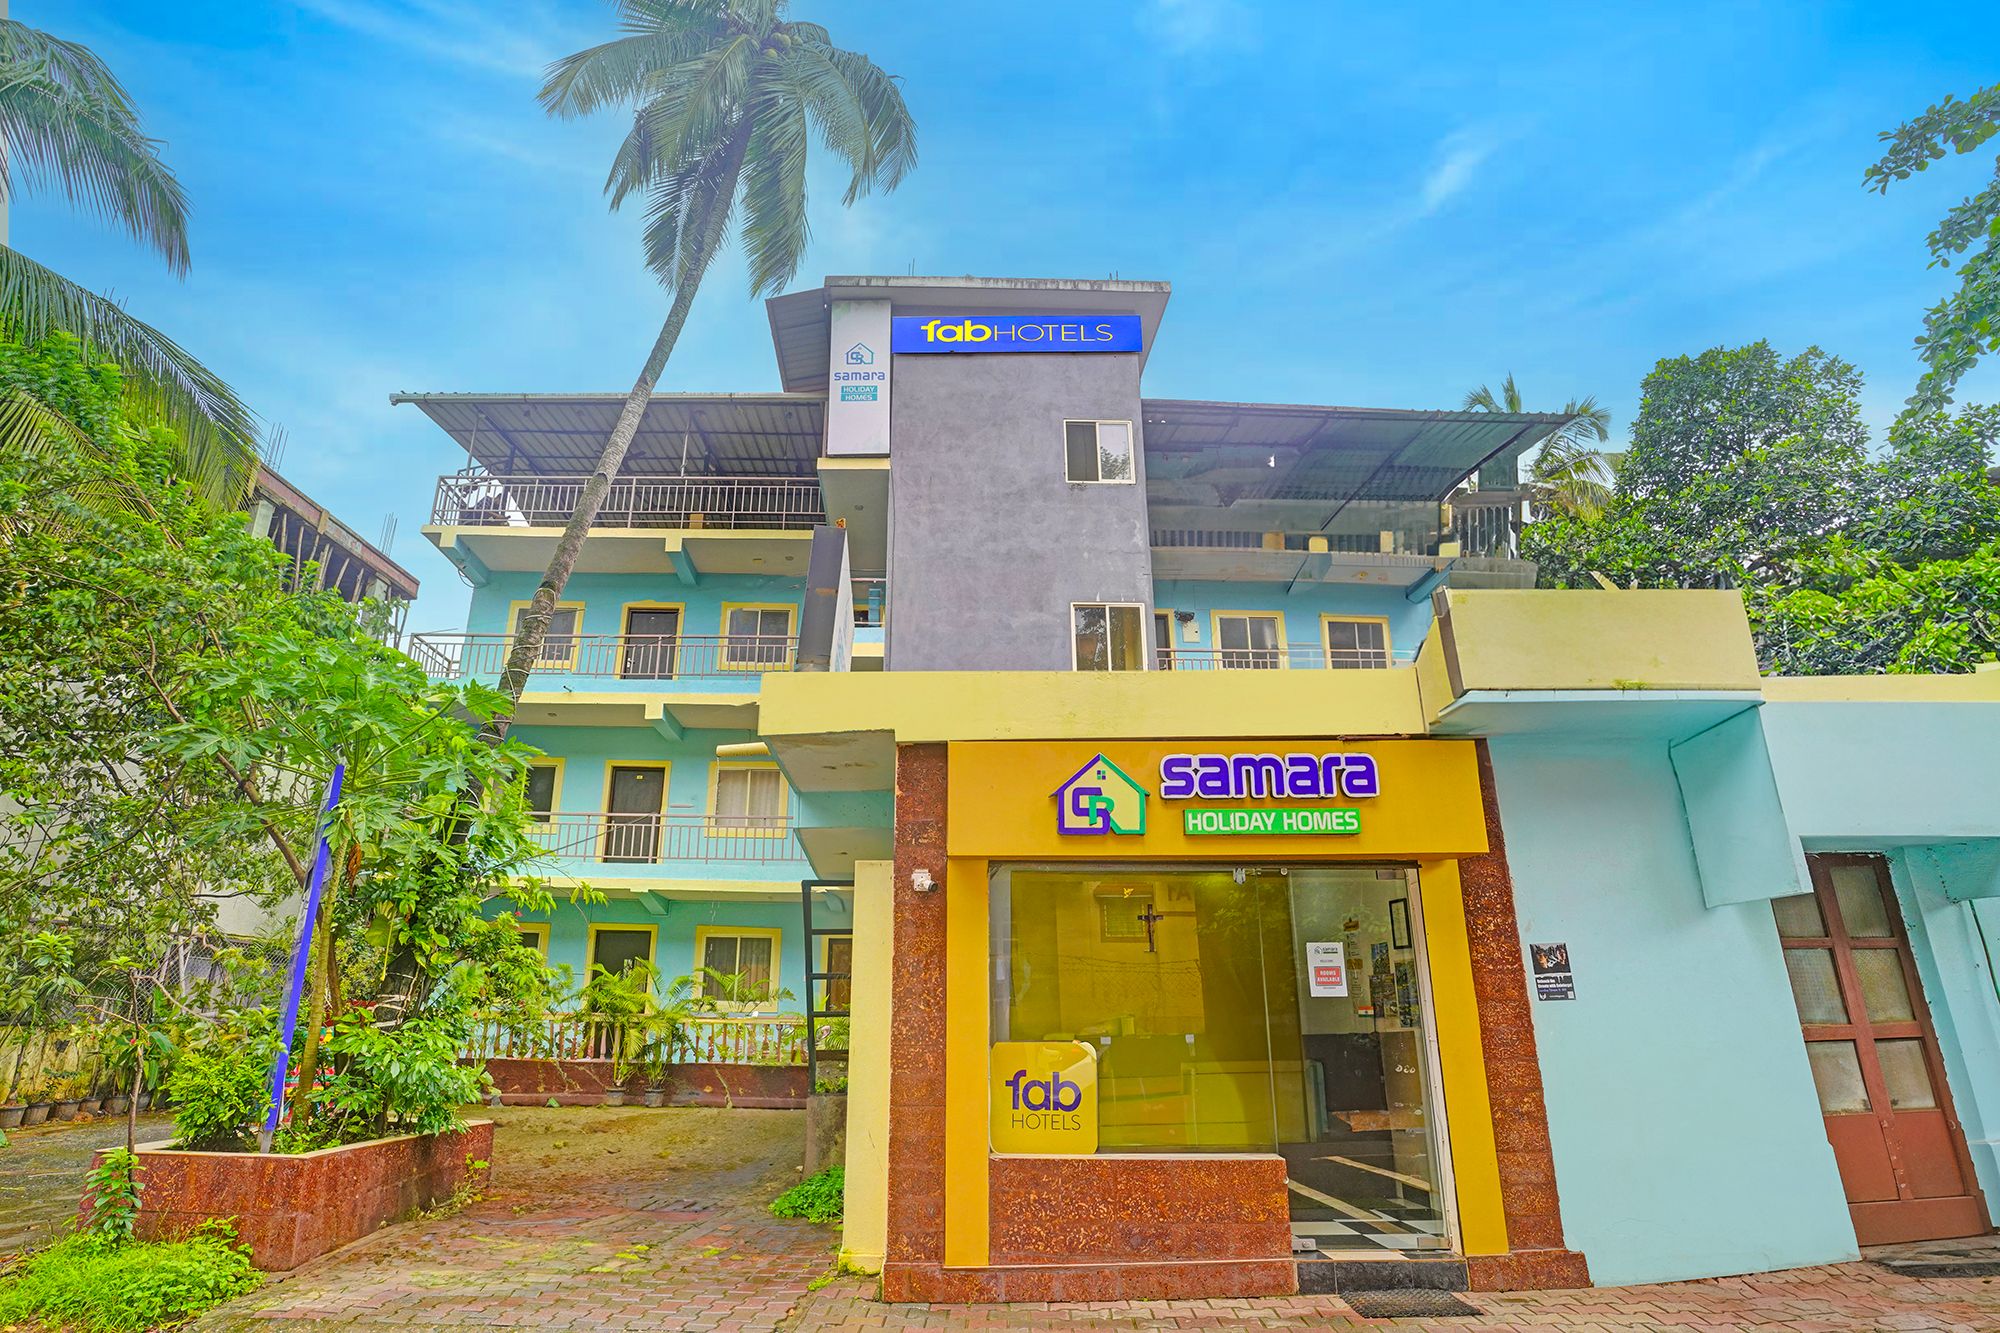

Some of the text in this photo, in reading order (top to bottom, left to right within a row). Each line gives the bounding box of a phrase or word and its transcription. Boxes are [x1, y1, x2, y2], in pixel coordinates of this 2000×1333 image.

[920, 319, 1114, 343] fabHOTELS
[834, 371, 886, 381] samara
[1160, 753, 1380, 799] samara
[1187, 810, 1359, 831] HOLIDAY HOMES
[1005, 1069, 1082, 1112] fab
[1011, 1113, 1081, 1131] HOTELS
